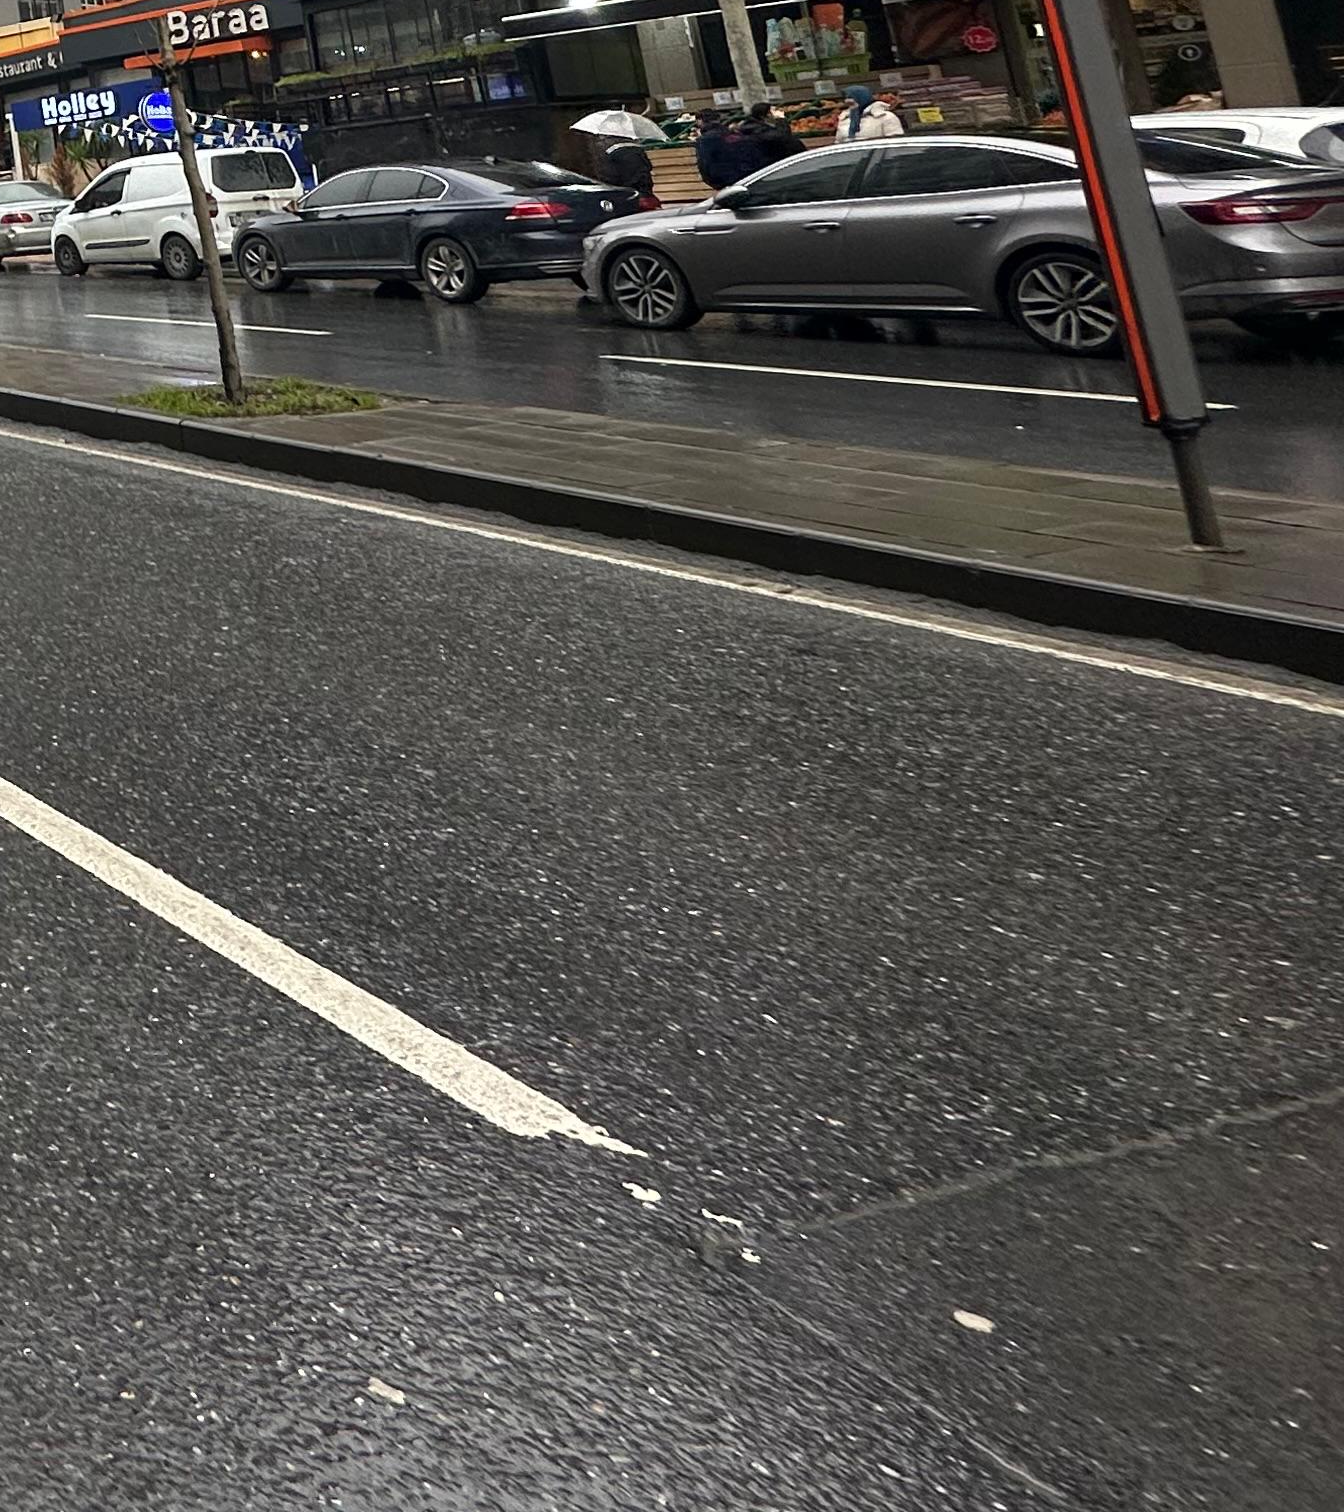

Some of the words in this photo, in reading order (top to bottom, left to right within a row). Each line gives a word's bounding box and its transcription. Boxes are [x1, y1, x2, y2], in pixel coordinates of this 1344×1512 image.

[166, 3, 270, 45] Baraa
[47, 52, 58, 68] &
[41, 90, 116, 120] Holley
